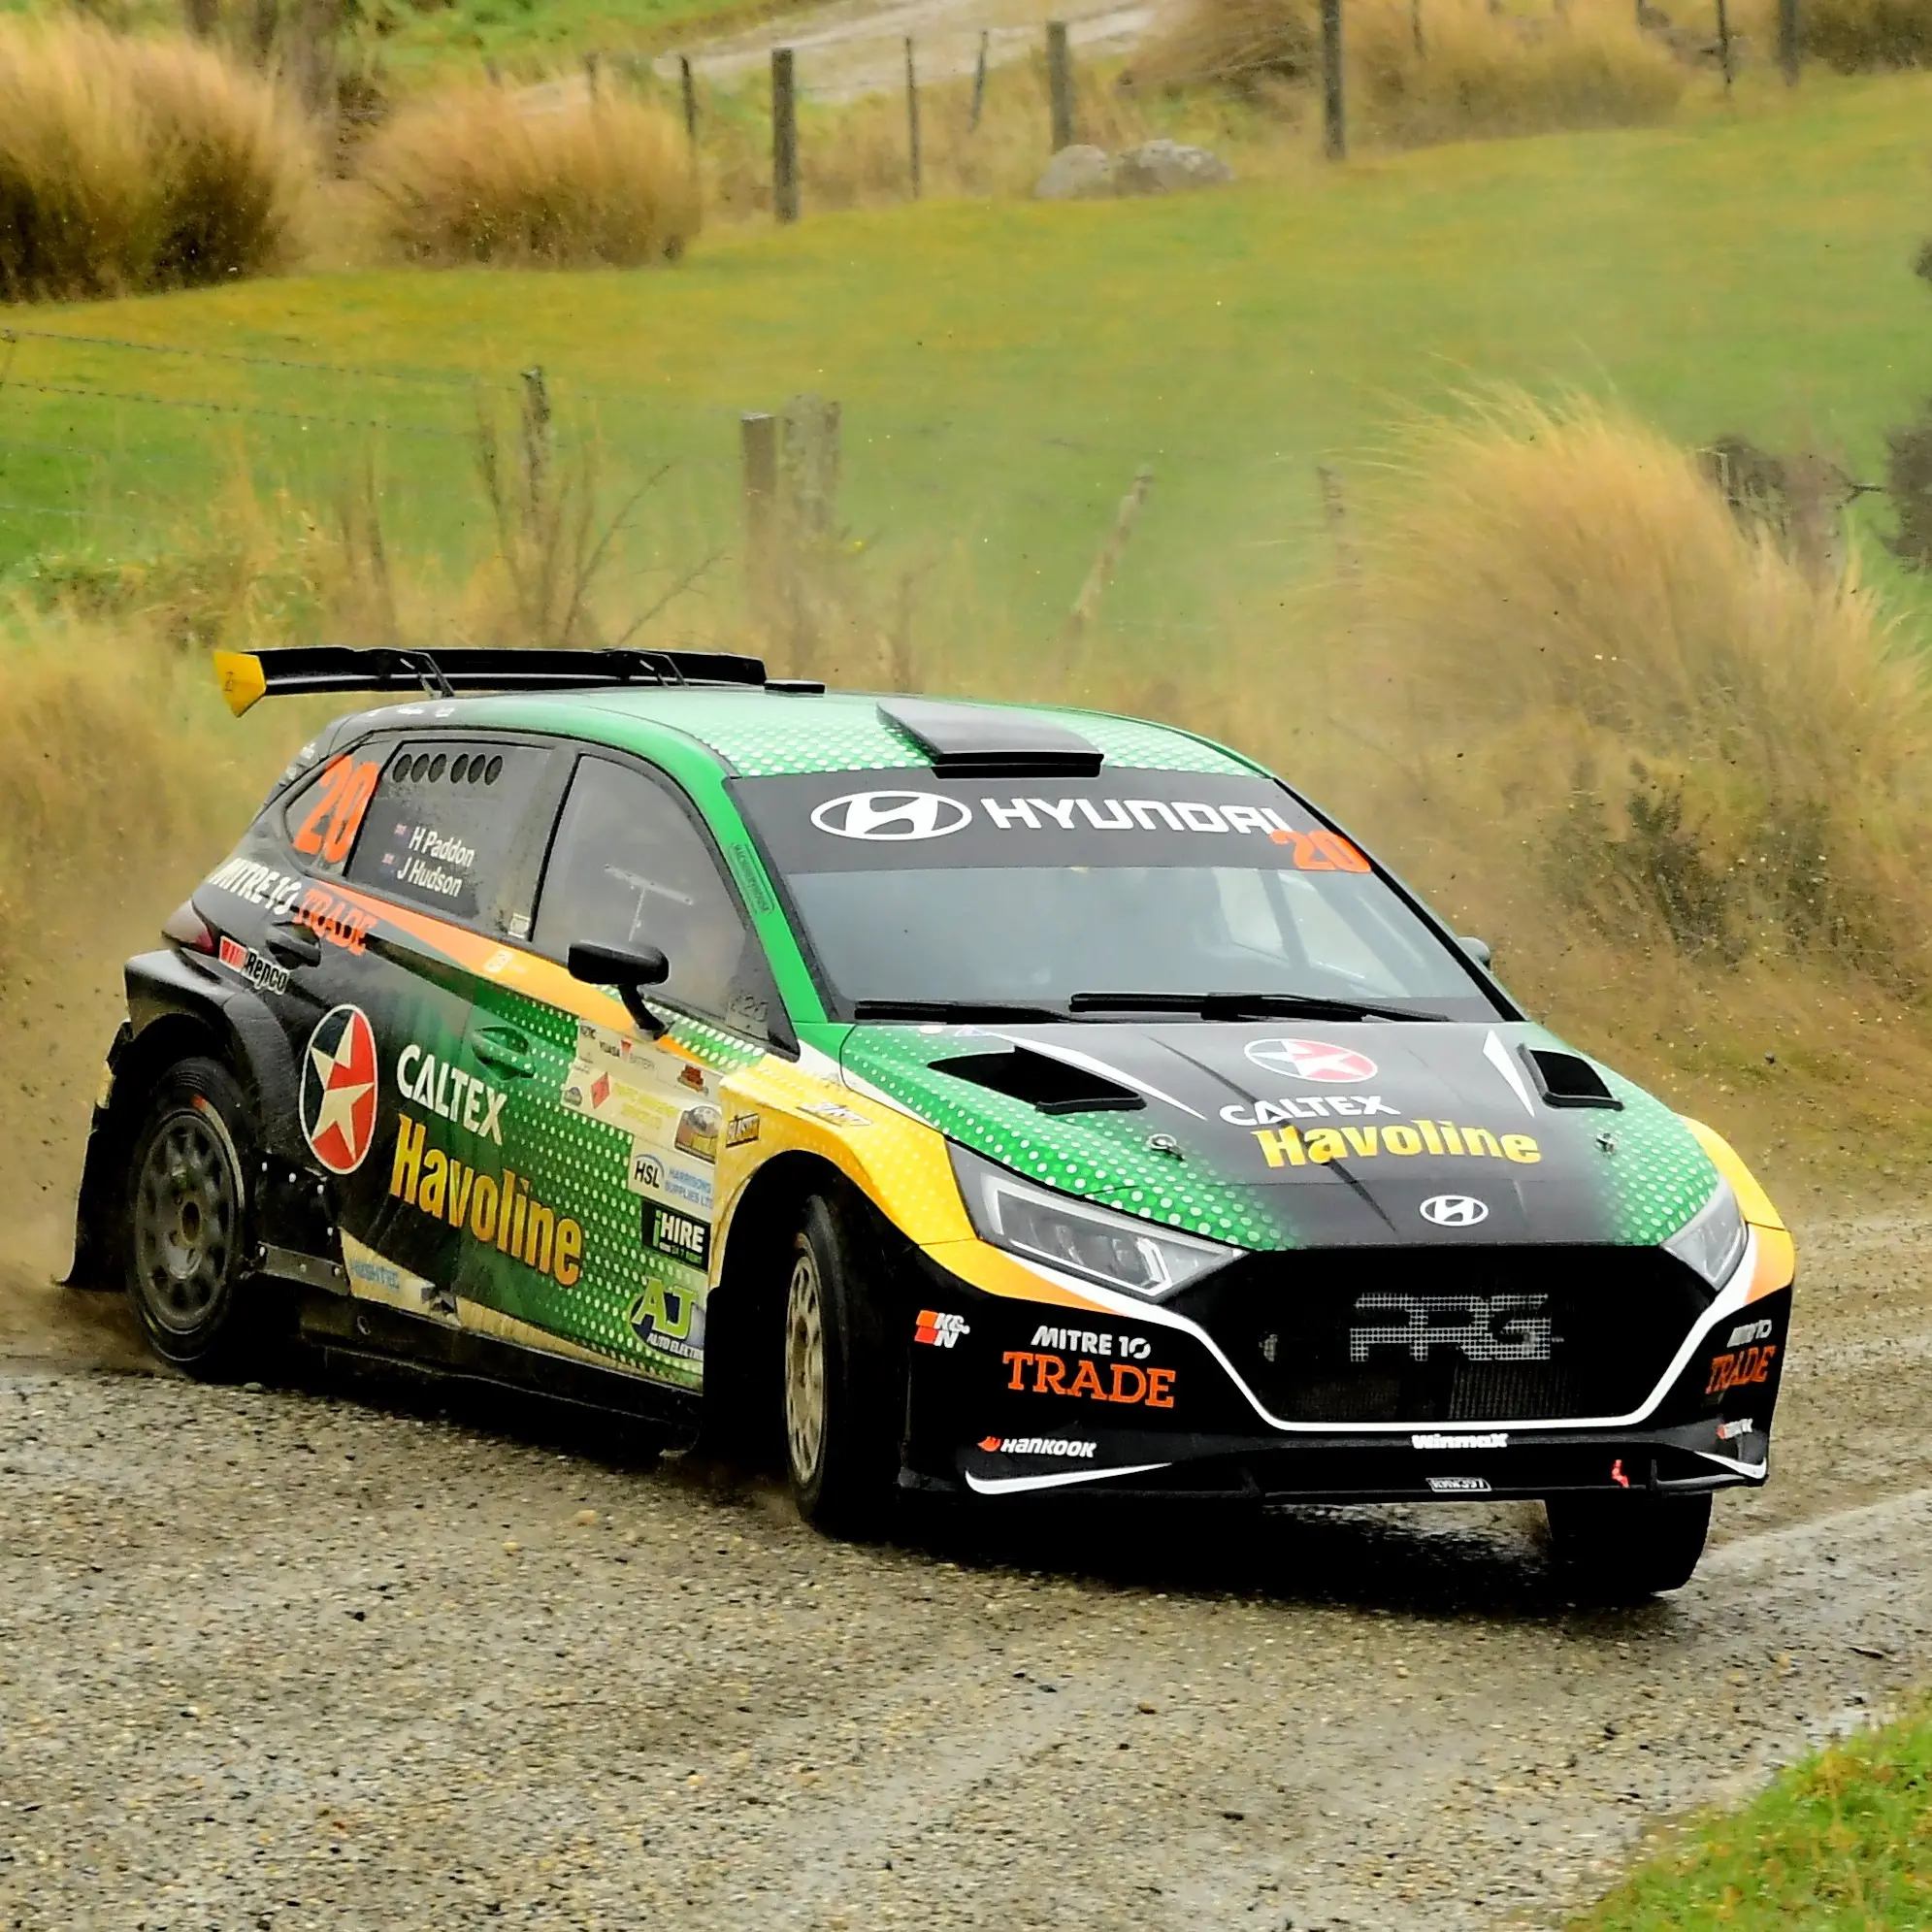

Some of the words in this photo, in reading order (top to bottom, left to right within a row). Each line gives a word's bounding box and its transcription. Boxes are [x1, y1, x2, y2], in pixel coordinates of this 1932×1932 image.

[292, 753, 380, 863] 20
[980, 798, 1293, 835] HYUNDAI
[409, 828, 422, 849] H
[421, 830, 475, 867] Paddon
[1270, 830, 1372, 872] 20
[397, 858, 409, 880] J
[409, 861, 463, 897] Hudson
[293, 887, 378, 956] TRADE
[244, 950, 289, 995] Repco
[397, 1044, 508, 1146] CALTEX
[1219, 1095, 1401, 1127] CALTEX
[1250, 1119, 1543, 1168] Havoline
[634, 1160, 661, 1190] HSL
[389, 1114, 582, 1287] Havoline
[632, 1275, 697, 1340] AJ
[1031, 1326, 1113, 1357] MITRE
[1118, 1335, 1152, 1359] 10
[1002, 1350, 1177, 1409] TRADE
[1705, 1345, 1778, 1395] TRADE
